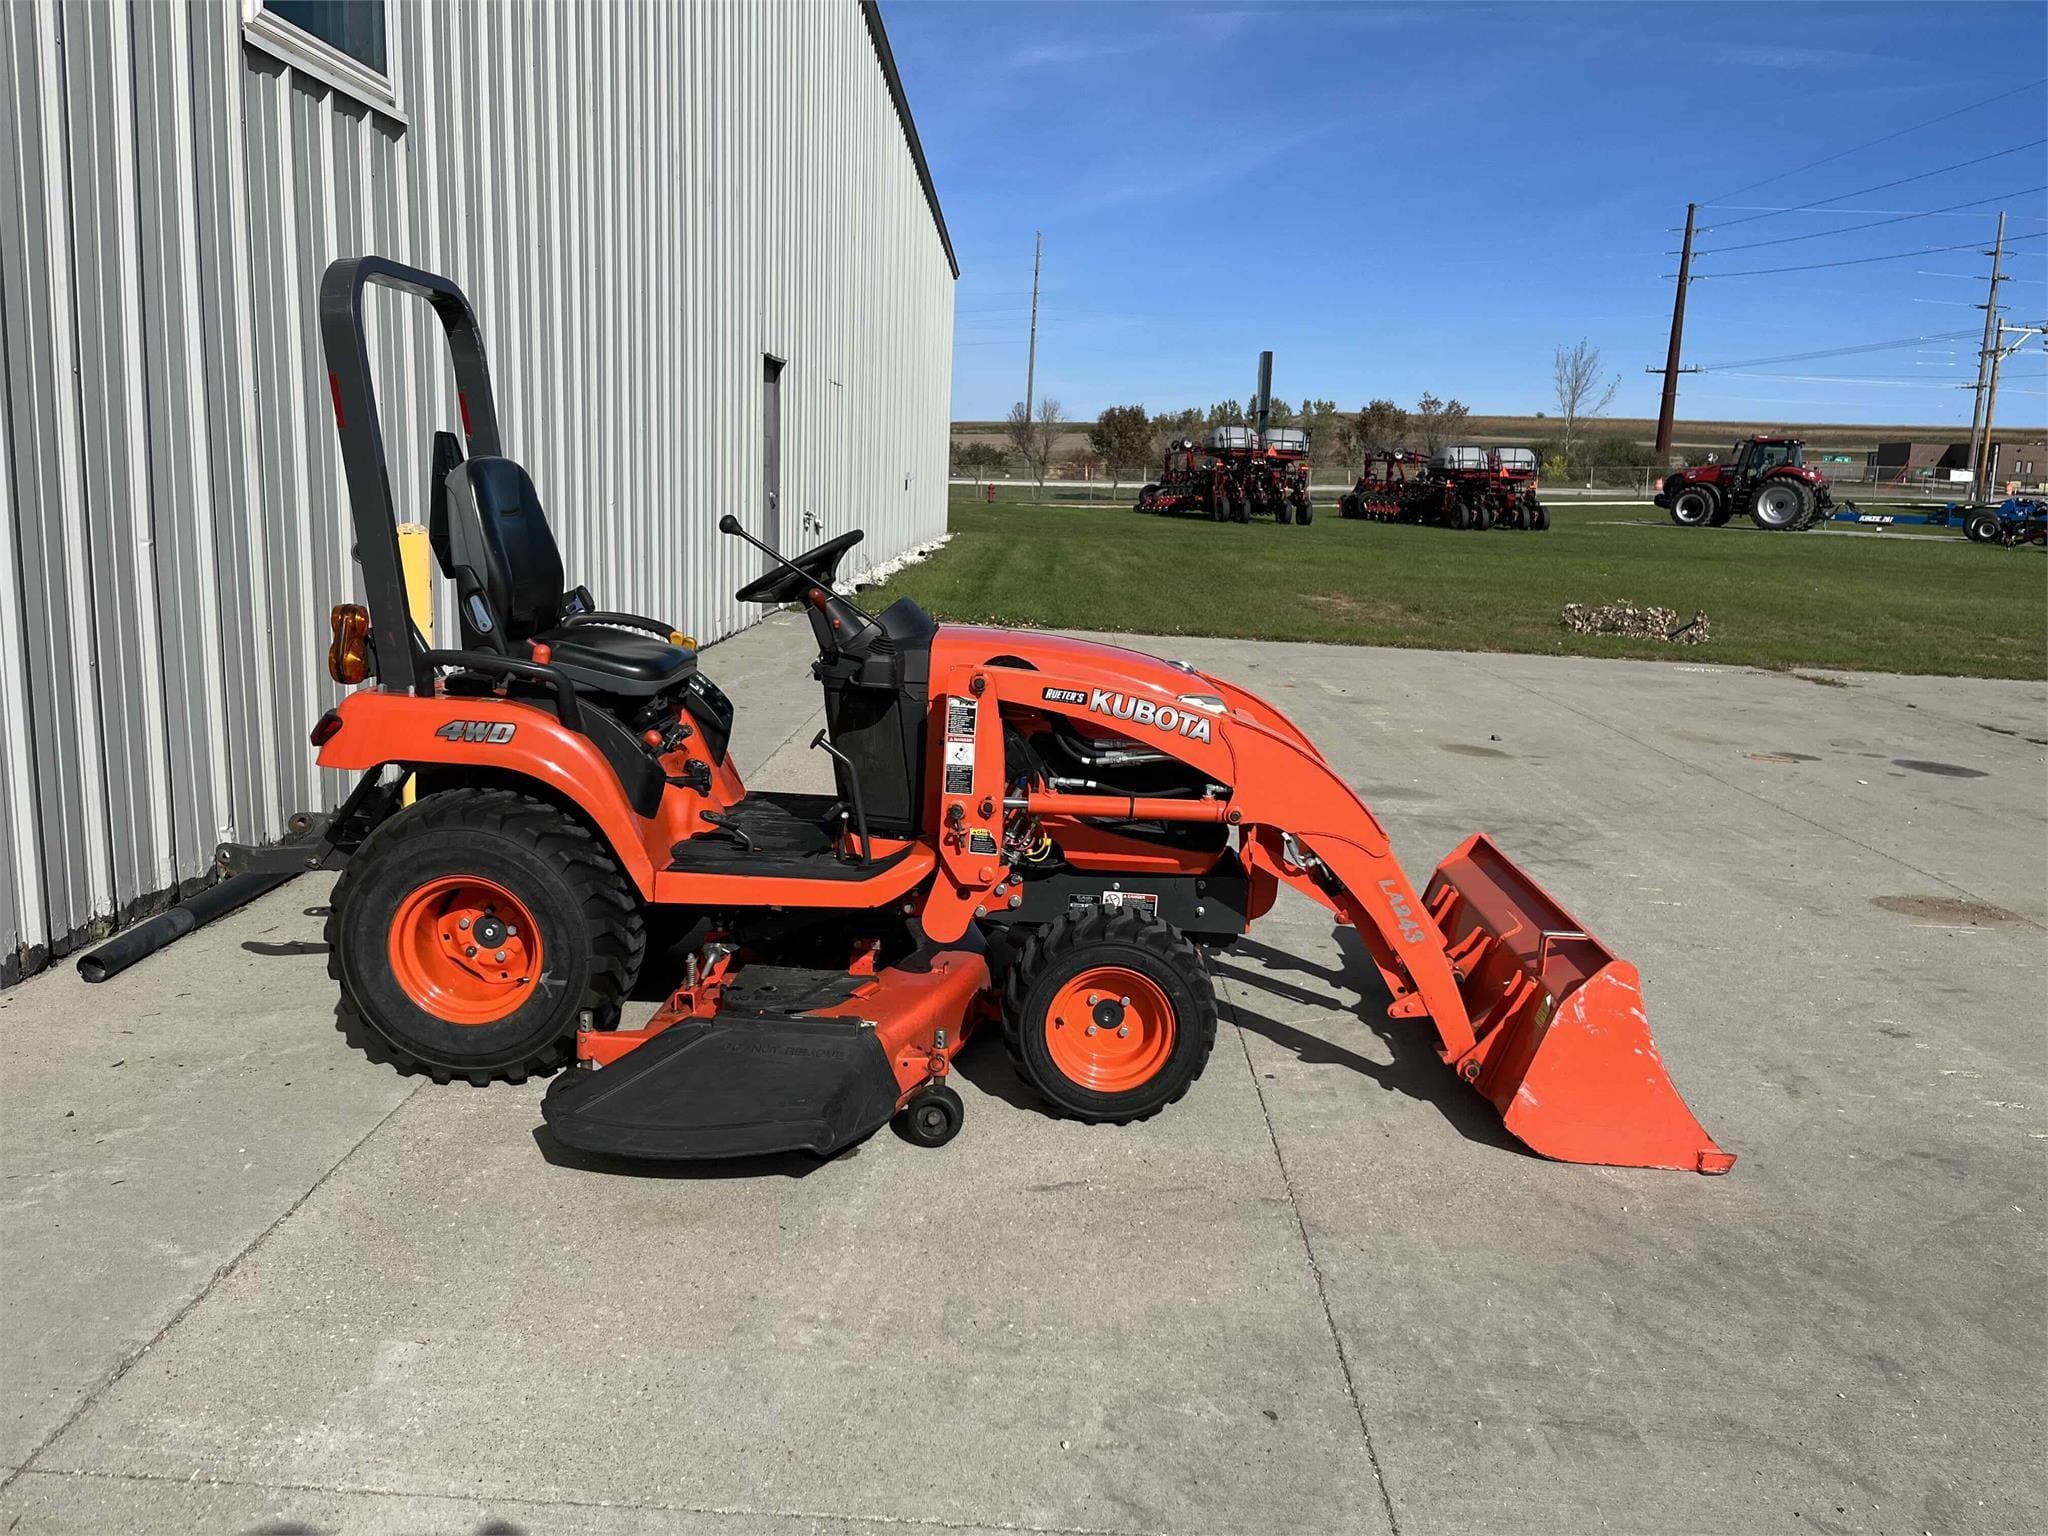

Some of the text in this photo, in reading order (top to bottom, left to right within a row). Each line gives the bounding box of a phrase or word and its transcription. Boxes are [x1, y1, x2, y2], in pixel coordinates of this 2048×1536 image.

[1045, 688, 1085, 703] RUETER'S
[435, 720, 517, 744] 4WD
[1089, 688, 1211, 744] KUBOTA
[1378, 879, 1425, 944] LA243
